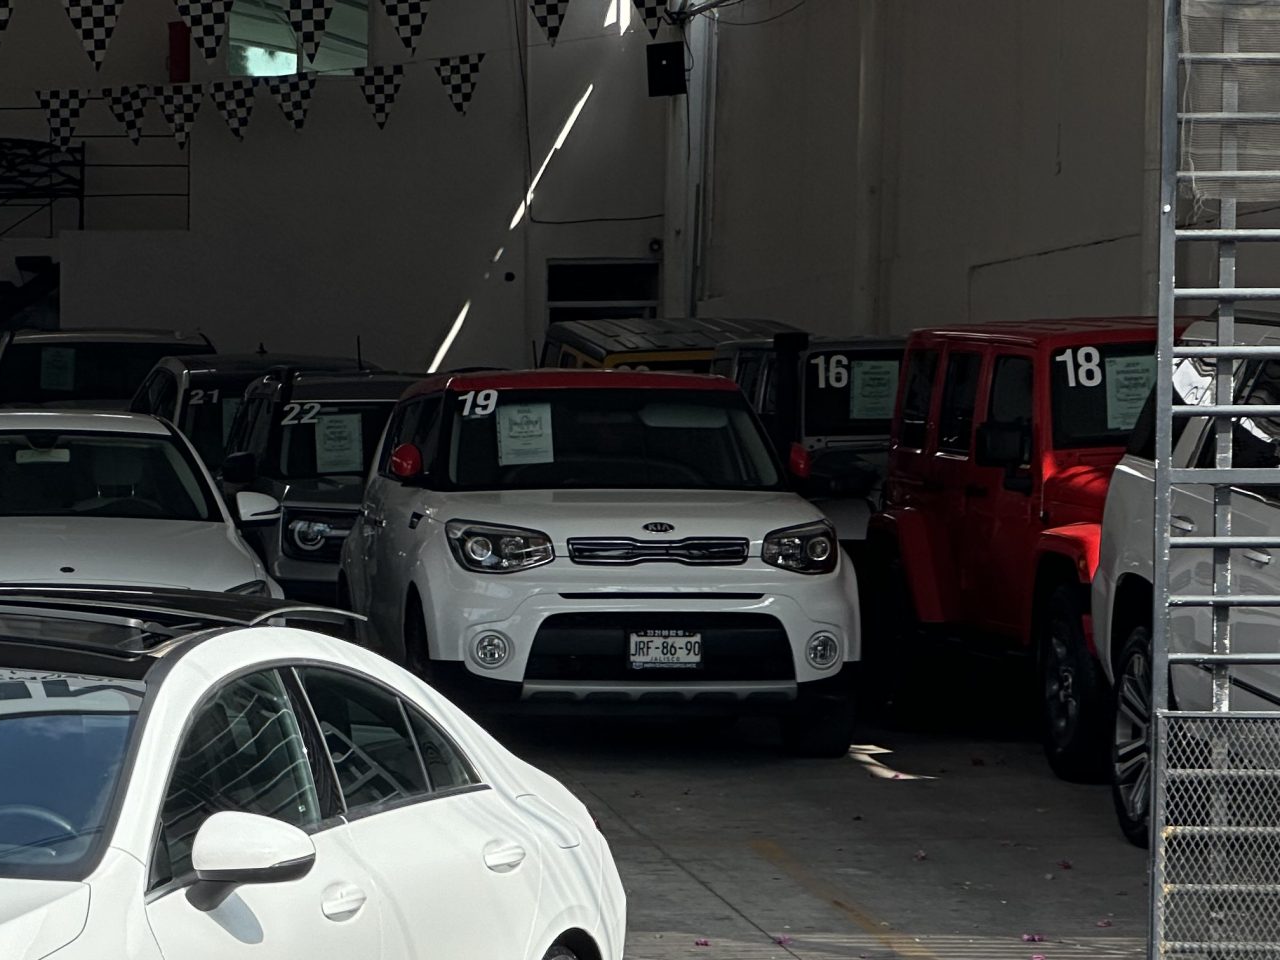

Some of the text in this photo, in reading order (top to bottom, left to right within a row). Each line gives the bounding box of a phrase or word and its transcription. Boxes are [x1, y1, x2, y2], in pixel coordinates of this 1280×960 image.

[810, 354, 849, 389] 16
[1054, 346, 1103, 388] 18
[188, 388, 221, 406] 21
[457, 389, 499, 417] 19
[280, 402, 322, 426] 22
[647, 523, 670, 532] KIA
[631, 640, 701, 656] JRF-86-90
